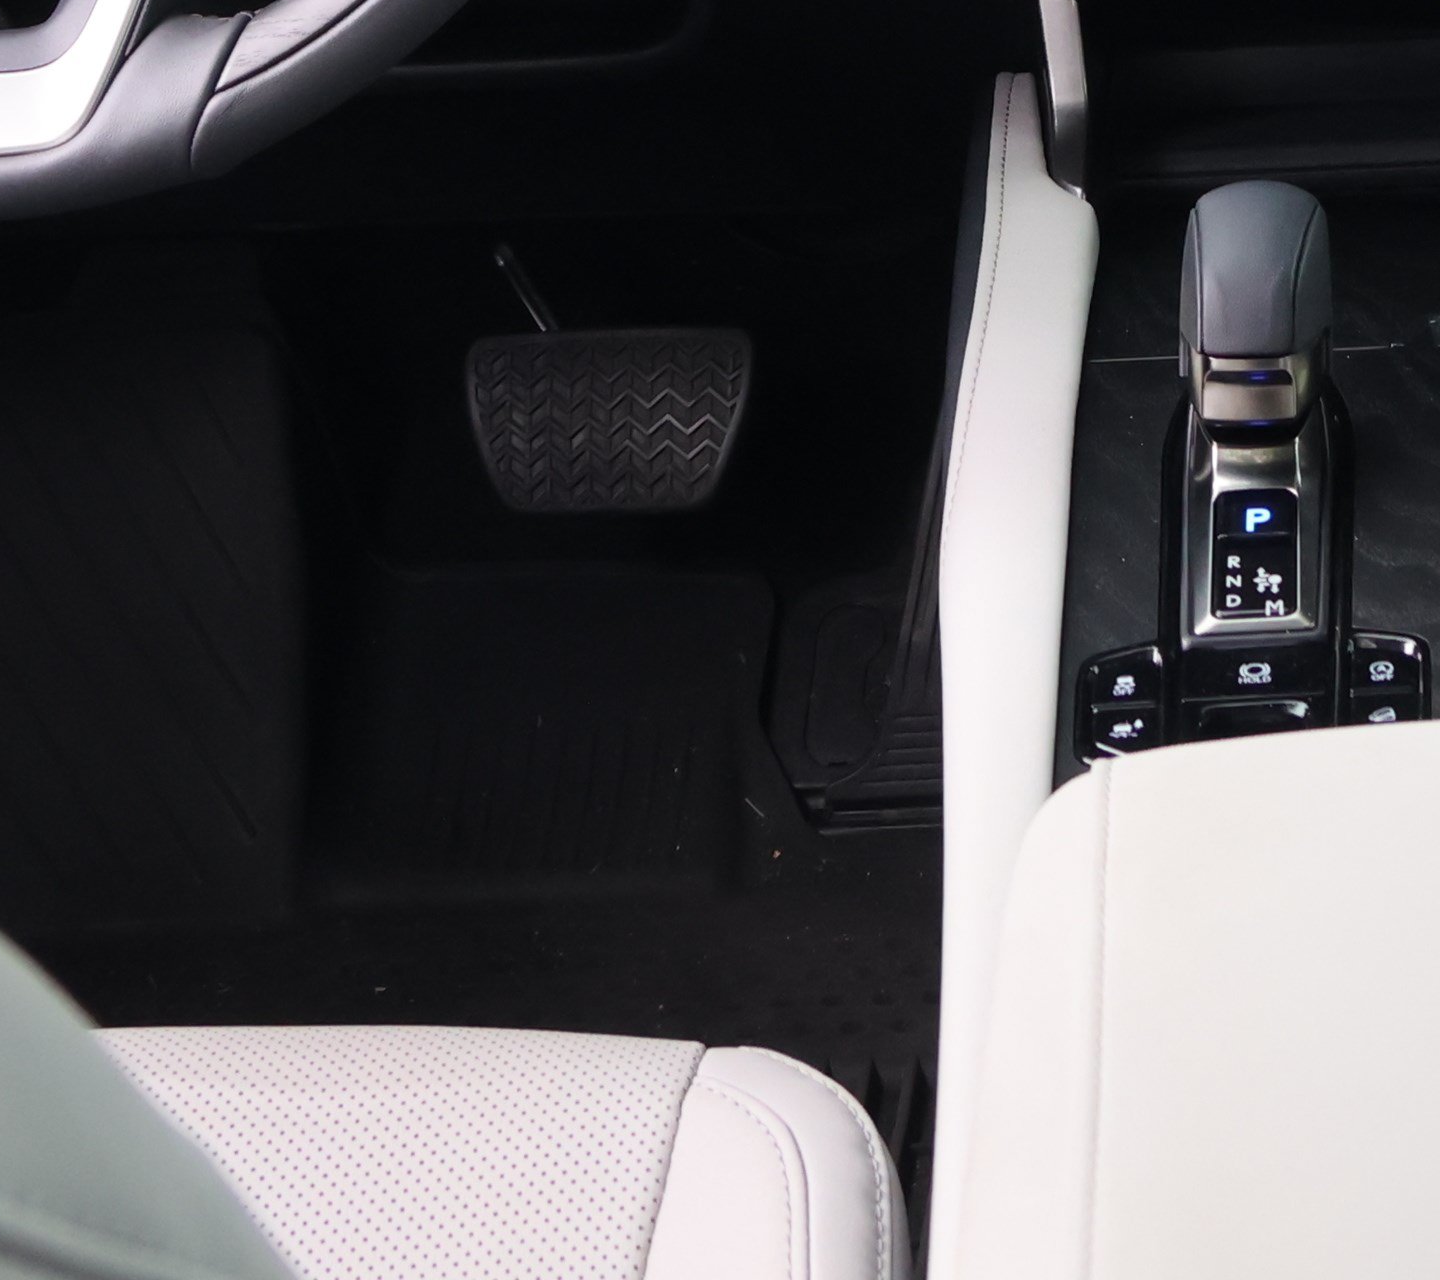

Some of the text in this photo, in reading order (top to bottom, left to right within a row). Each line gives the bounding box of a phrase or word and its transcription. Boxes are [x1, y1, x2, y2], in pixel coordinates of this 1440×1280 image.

[1245, 507, 1271, 532] P
[1227, 555, 1241, 568] R
[1225, 574, 1242, 588] N
[1226, 594, 1242, 608] D
[1264, 599, 1285, 617] M
